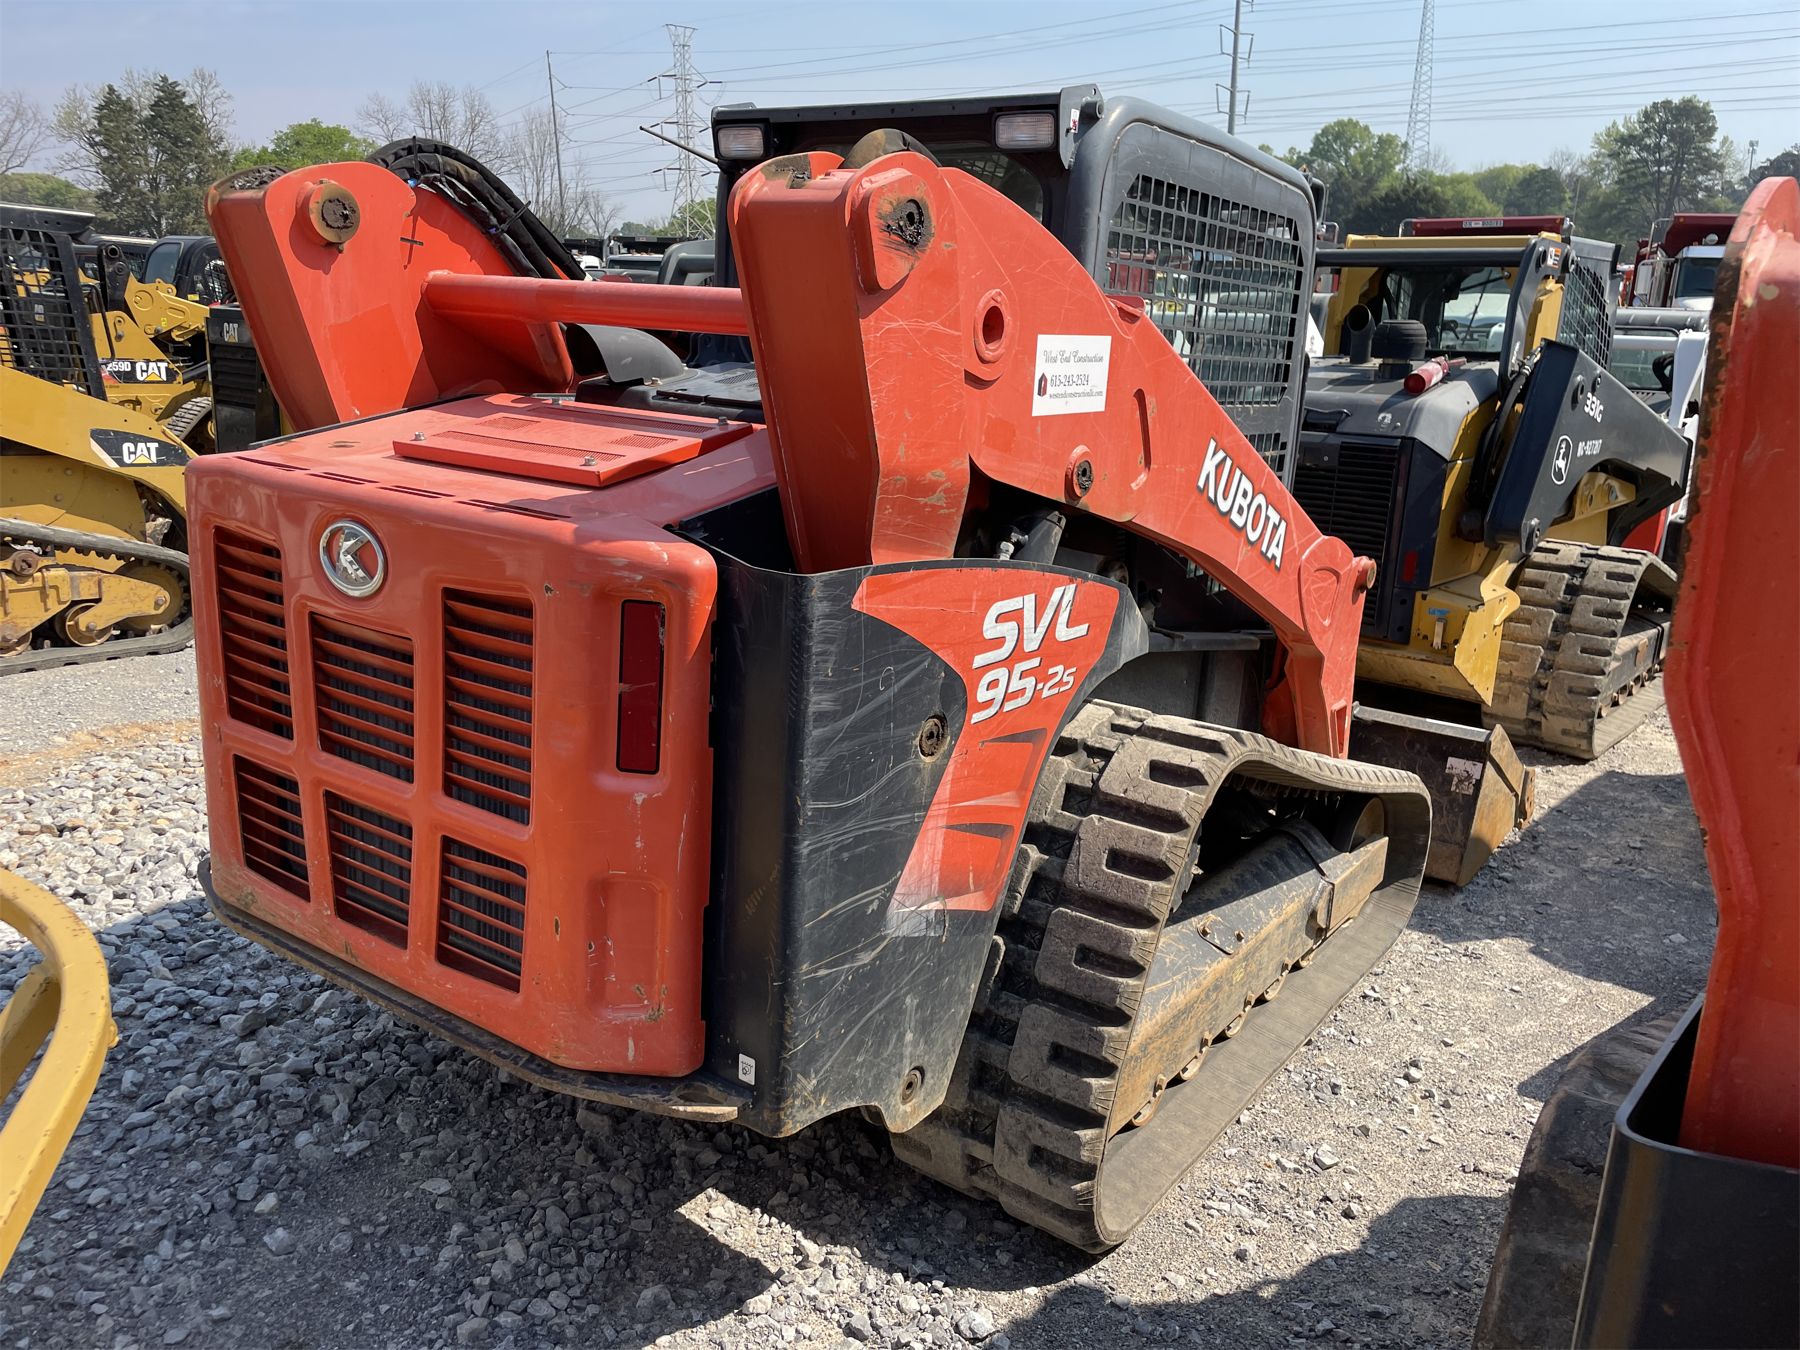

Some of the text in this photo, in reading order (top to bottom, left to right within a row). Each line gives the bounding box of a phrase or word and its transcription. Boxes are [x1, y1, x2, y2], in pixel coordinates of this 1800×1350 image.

[223, 322, 239, 342] CAT
[1072, 350, 1104, 363] Construction
[135, 361, 168, 381] CAT
[122, 442, 158, 464] CAT
[1197, 437, 1287, 571] KUBOTA
[972, 583, 1090, 669] SVL
